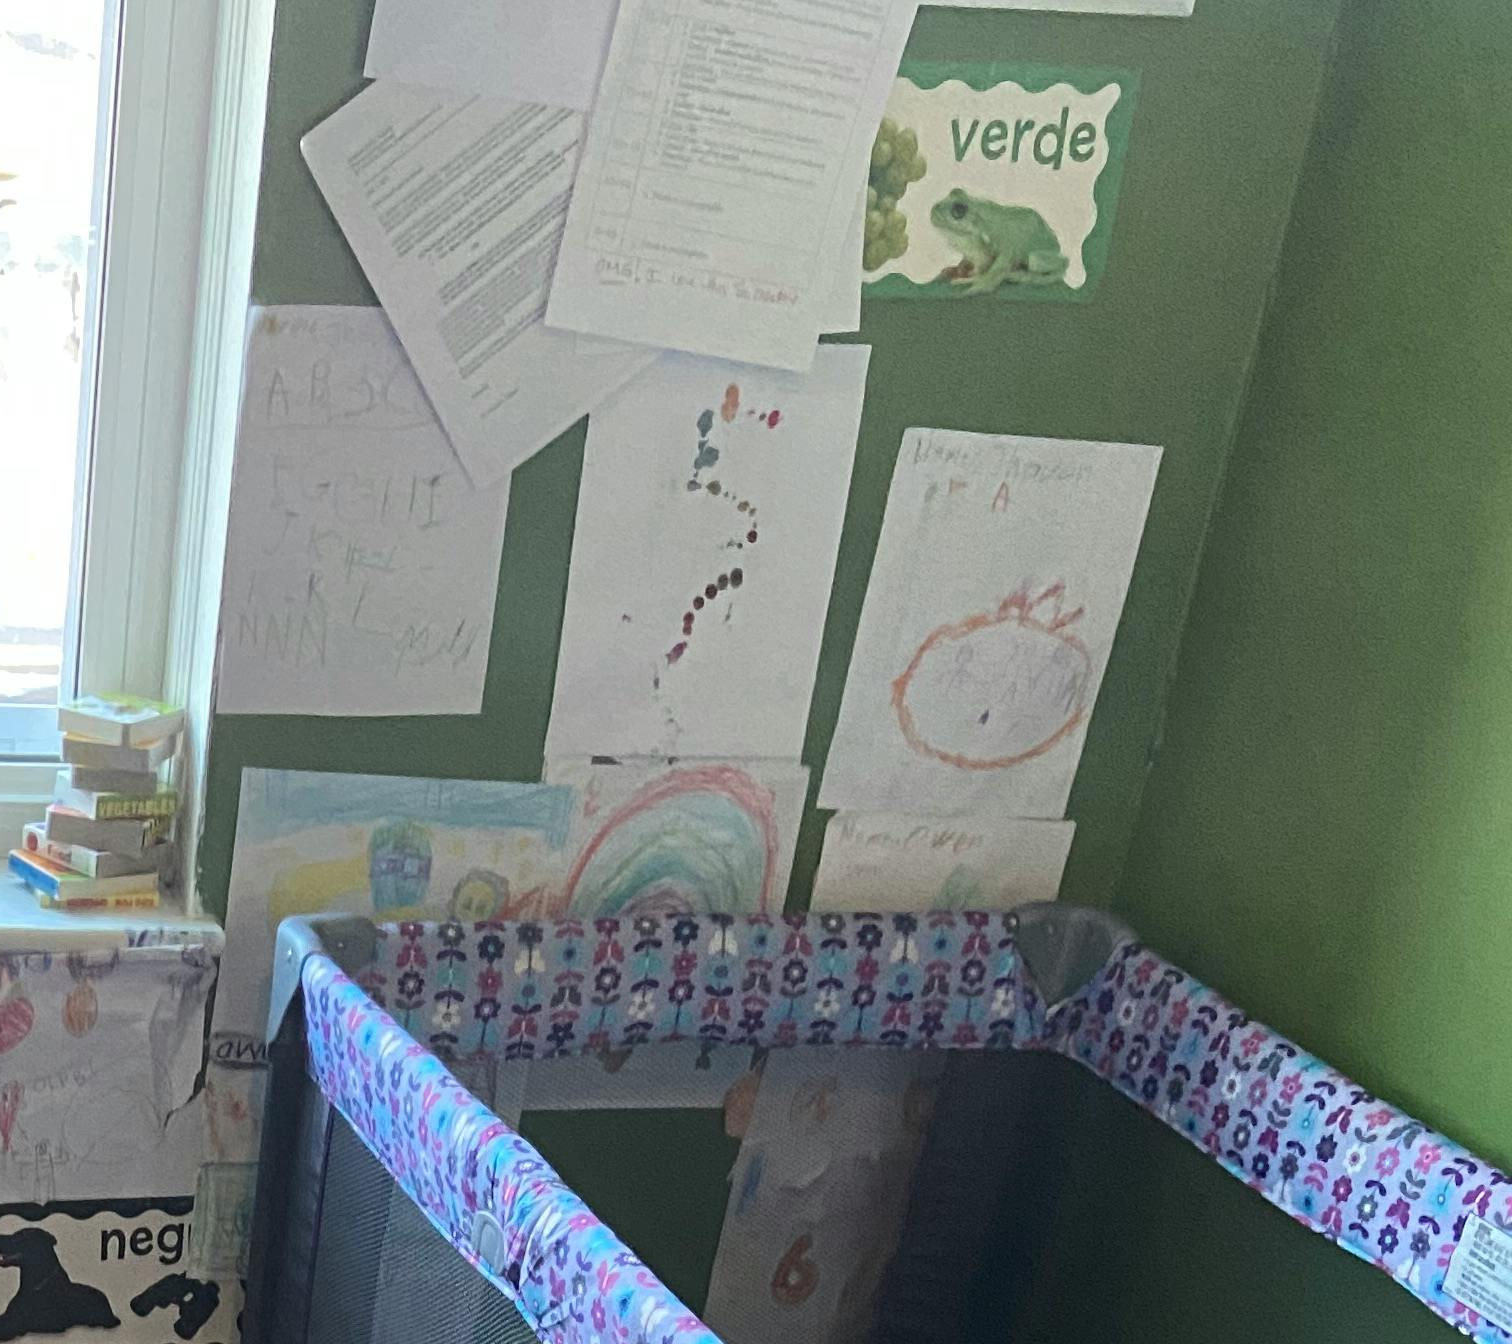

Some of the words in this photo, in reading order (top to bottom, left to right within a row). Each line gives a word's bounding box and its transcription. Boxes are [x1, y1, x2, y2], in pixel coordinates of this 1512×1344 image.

[951, 106, 1097, 170] verde
[97, 799, 176, 816] VEGETABLES
[100, 1222, 192, 1264] neg
[771, 1234, 820, 1307] 6
